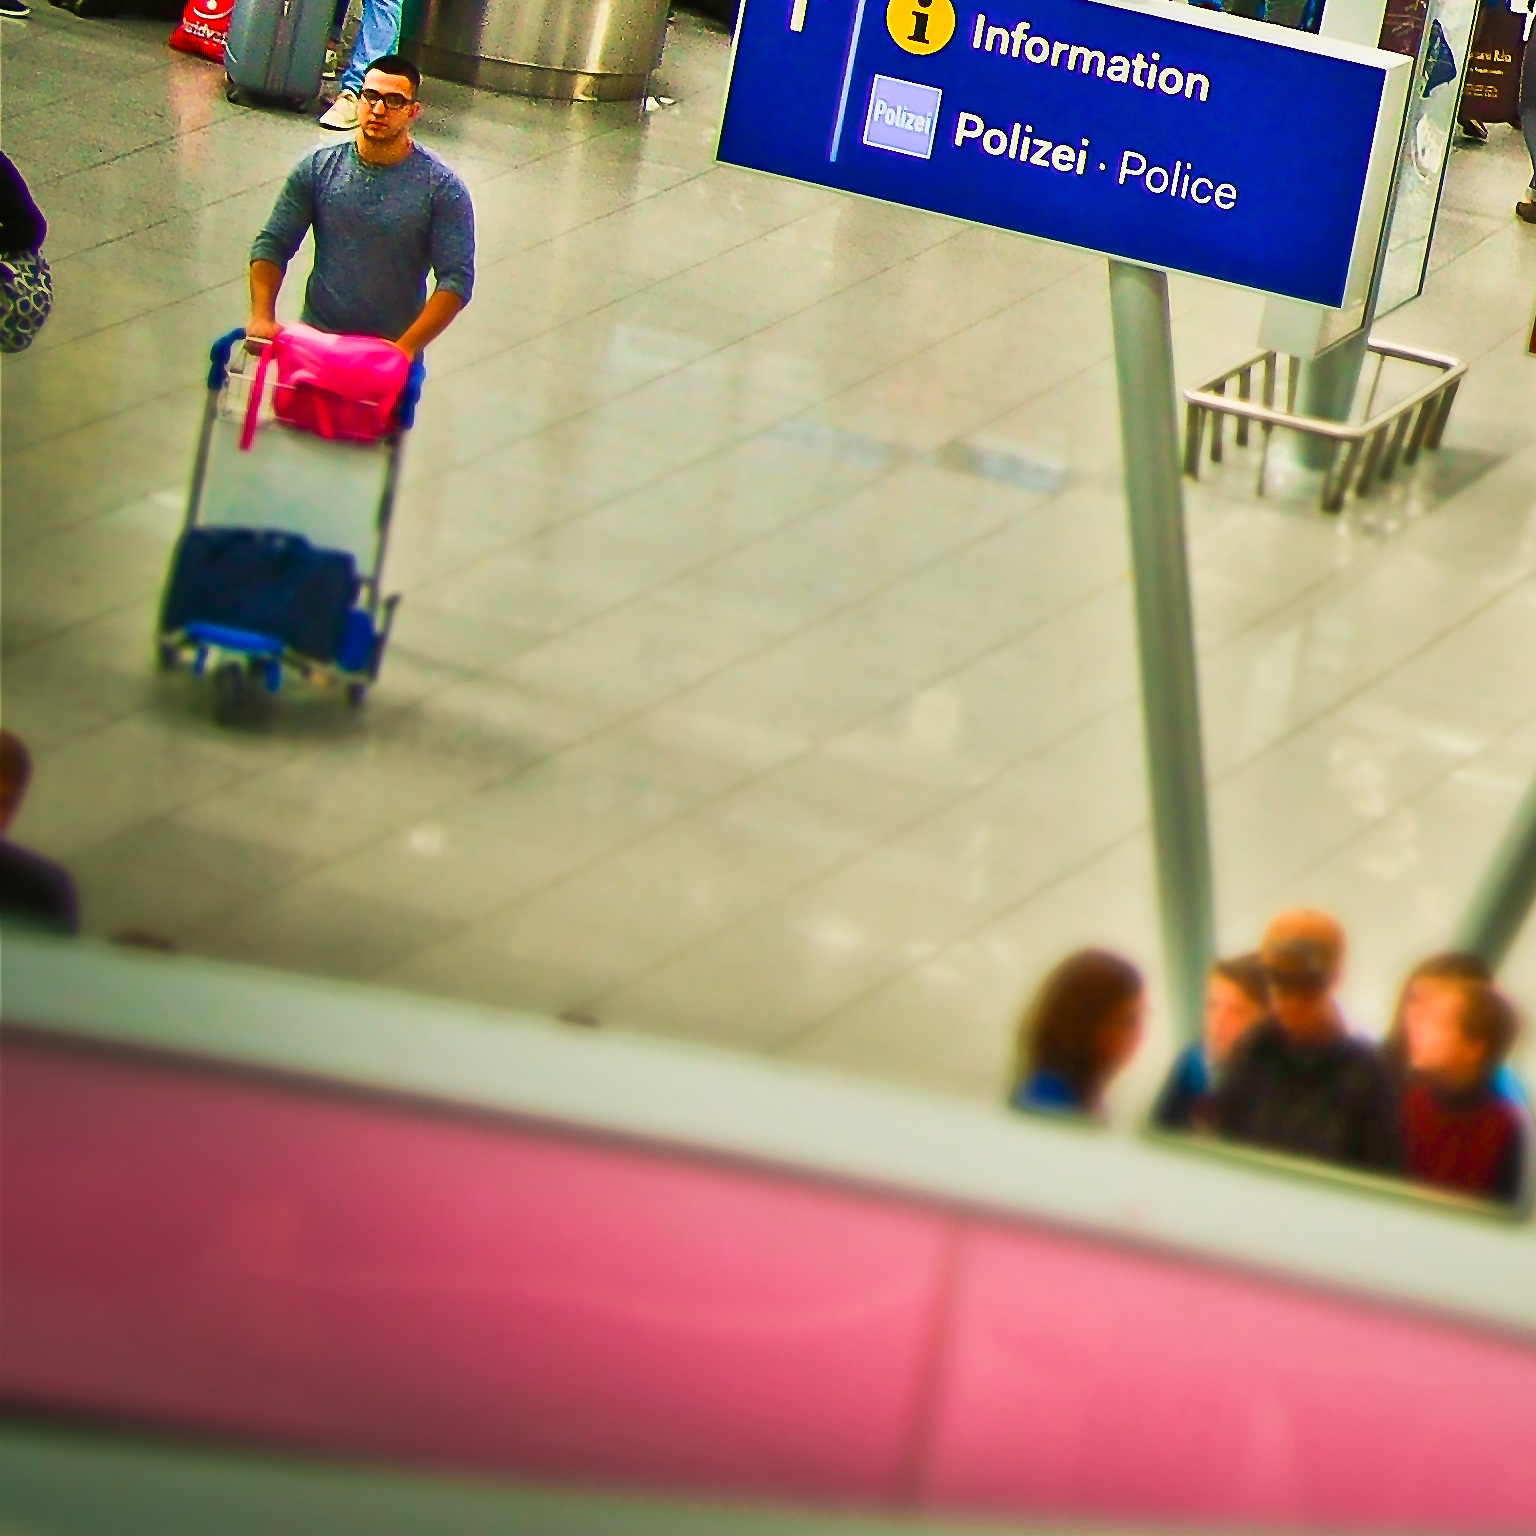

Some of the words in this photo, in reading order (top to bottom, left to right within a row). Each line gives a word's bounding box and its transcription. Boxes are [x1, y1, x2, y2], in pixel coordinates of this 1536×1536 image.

[971, 12, 1211, 102] Information
[873, 98, 933, 137] Polizei
[953, 110, 1091, 176] Polizei
[1117, 149, 1239, 211] Police
